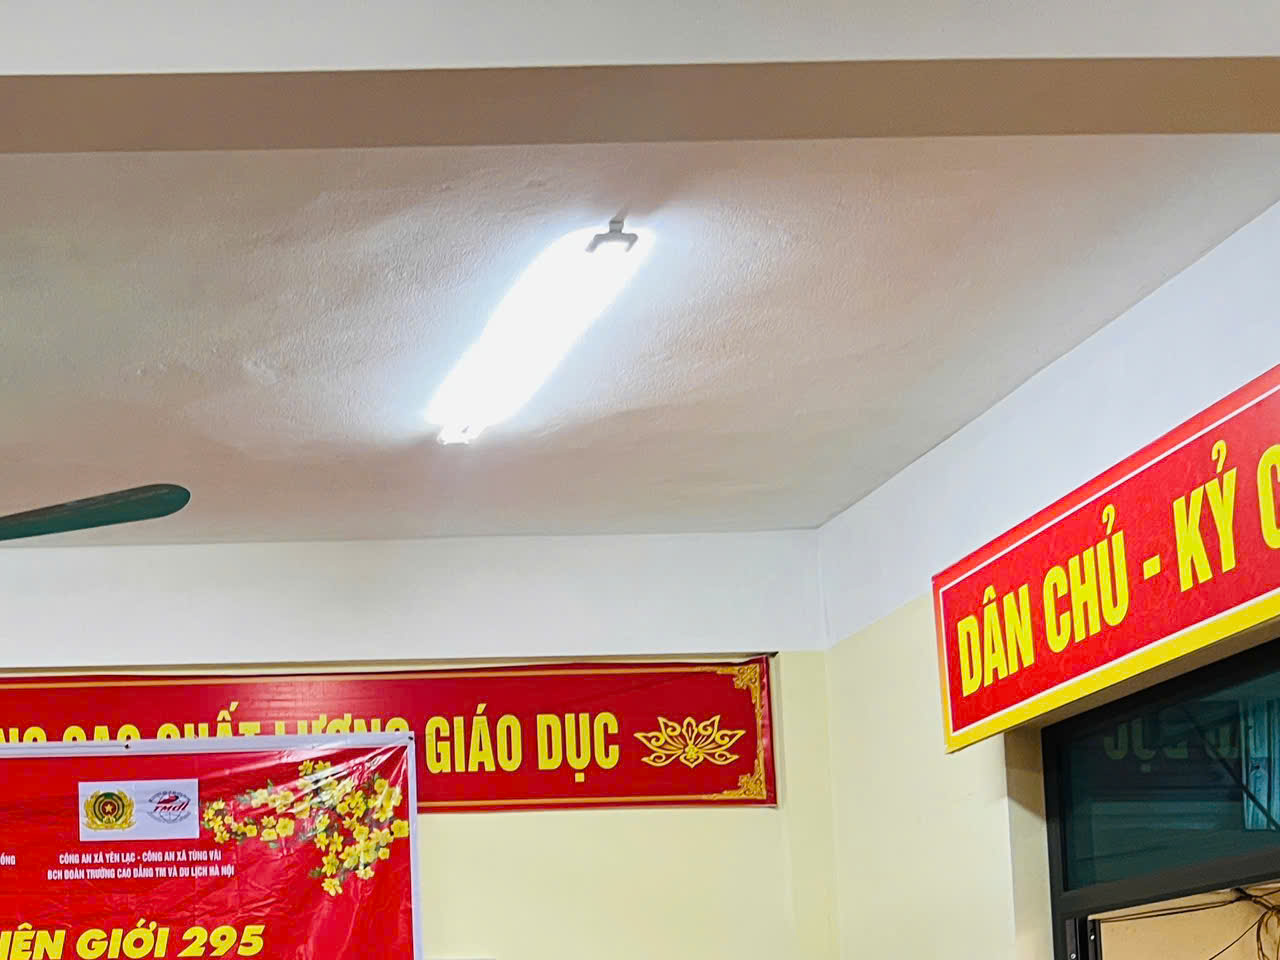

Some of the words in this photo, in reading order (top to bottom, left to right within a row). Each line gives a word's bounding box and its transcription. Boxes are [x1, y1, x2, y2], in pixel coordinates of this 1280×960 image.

[956, 585, 1035, 698] DÂN
[1042, 503, 1130, 654] CHỦ
[1173, 439, 1238, 593] KỶ
[426, 703, 520, 775] GIÁO
[538, 709, 621, 784] DỤC
[59, 851, 80, 865] CÔNG
[81, 853, 92, 864] AN
[93, 850, 104, 864] XÃ
[105, 850, 120, 864] YÊN
[121, 852, 136, 865] LẠC
[142, 849, 163, 862] CÔNG
[164, 851, 175, 862] AN
[176, 848, 187, 862] XÃ
[117, 867, 132, 879] CAO
[155, 866, 167, 878] TM
[167, 864, 178, 878] VÀ
[191, 865, 208, 879] LỊCH
[209, 863, 220, 877] HÀ
[221, 863, 235, 878] NỘI
[76, 917, 169, 959] GIỚI
[176, 924, 266, 957] 295
